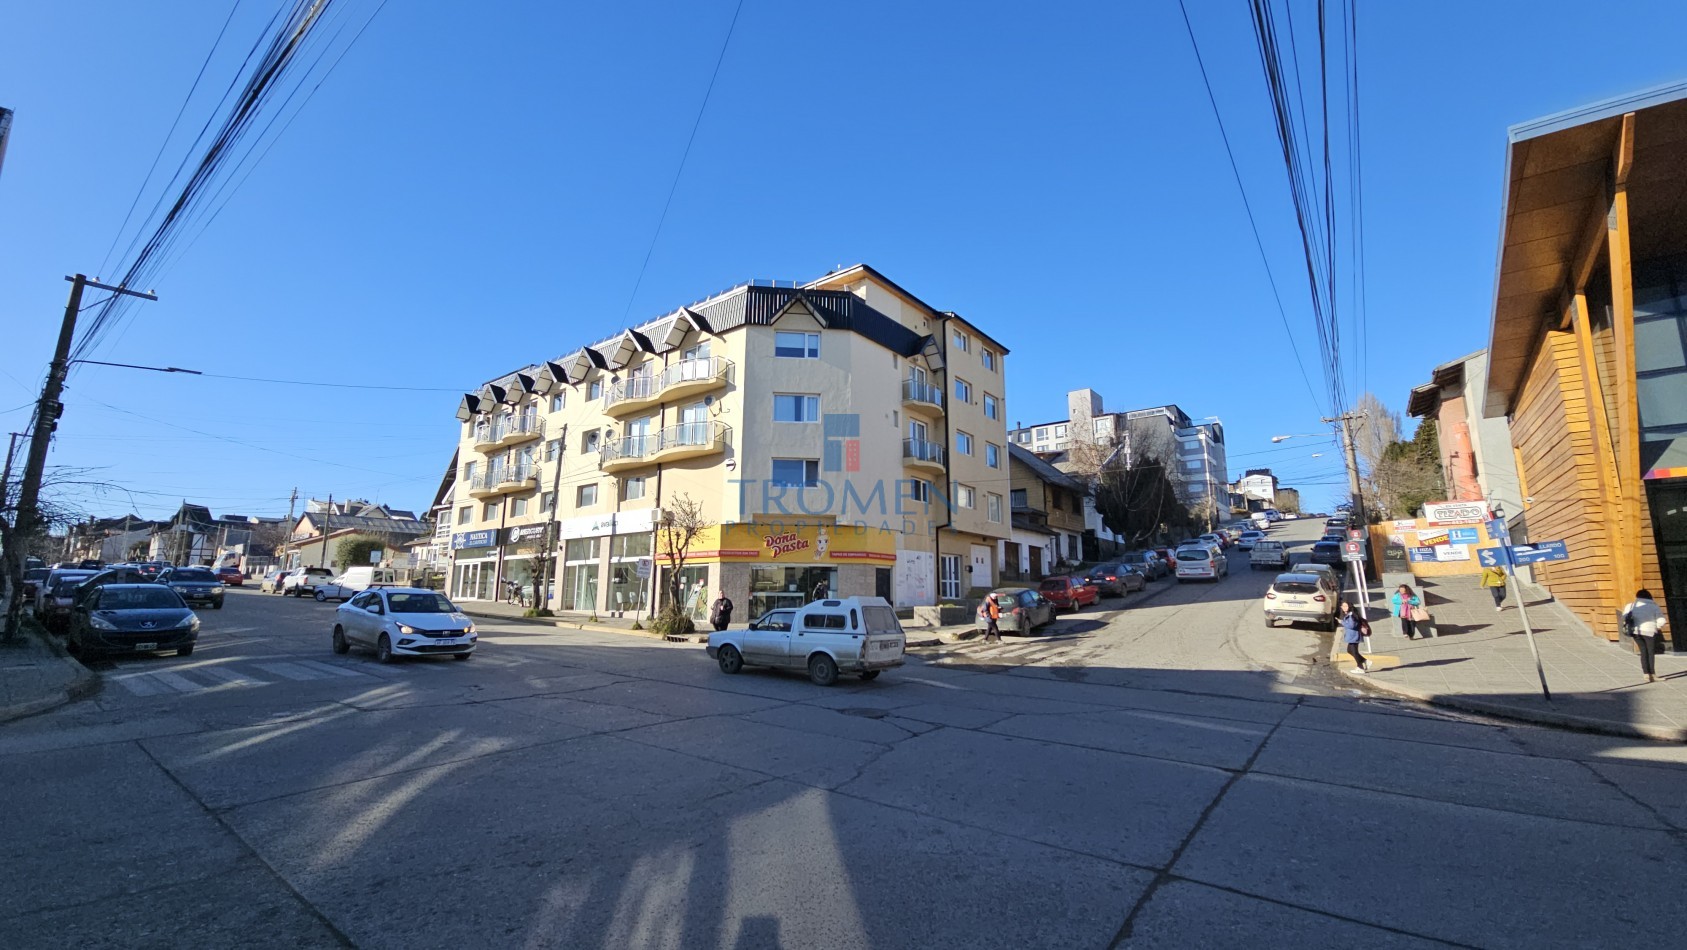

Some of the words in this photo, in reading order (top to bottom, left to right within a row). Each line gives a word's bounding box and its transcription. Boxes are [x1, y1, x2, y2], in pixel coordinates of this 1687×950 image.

[1437, 508, 1480, 518] TIZADO
[764, 532, 797, 547] Doña
[1424, 535, 1449, 545] VENDE
